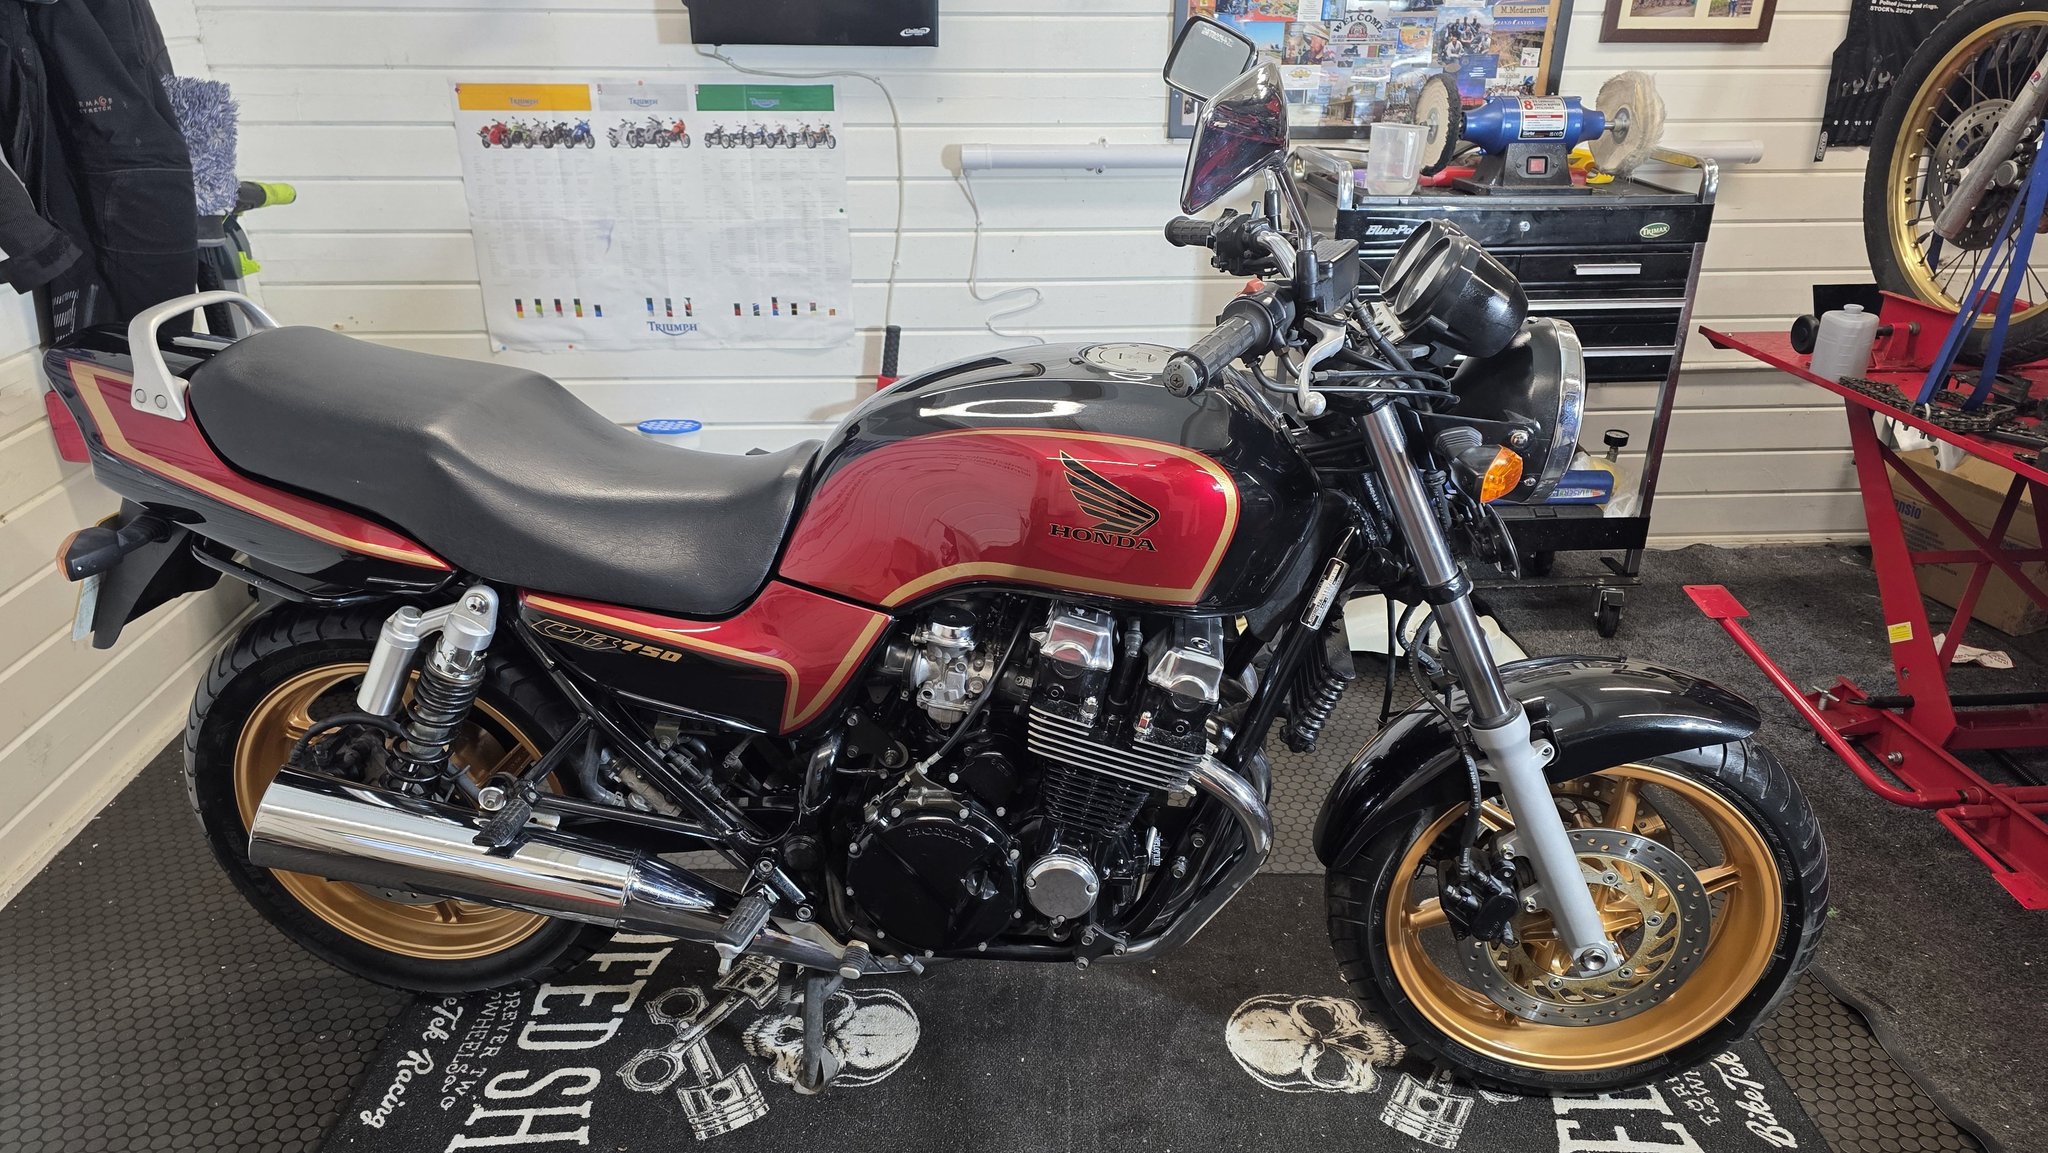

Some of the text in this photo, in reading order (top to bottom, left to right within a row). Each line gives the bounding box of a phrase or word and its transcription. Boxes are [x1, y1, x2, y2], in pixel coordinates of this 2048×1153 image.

[1333, 13, 1384, 33] WELCOME
[509, 97, 539, 106] TRIUMPH
[629, 97, 658, 107] TRIUMPH
[1523, 100, 1533, 110] 8
[1643, 226, 1668, 236] TRIMAX
[646, 321, 698, 335] TRIUMPH
[1048, 523, 1158, 552] HONDA
[621, 640, 683, 662] 750
[360, 996, 464, 1128] eTek Racing
[1710, 1051, 1798, 1149] BikeTek
